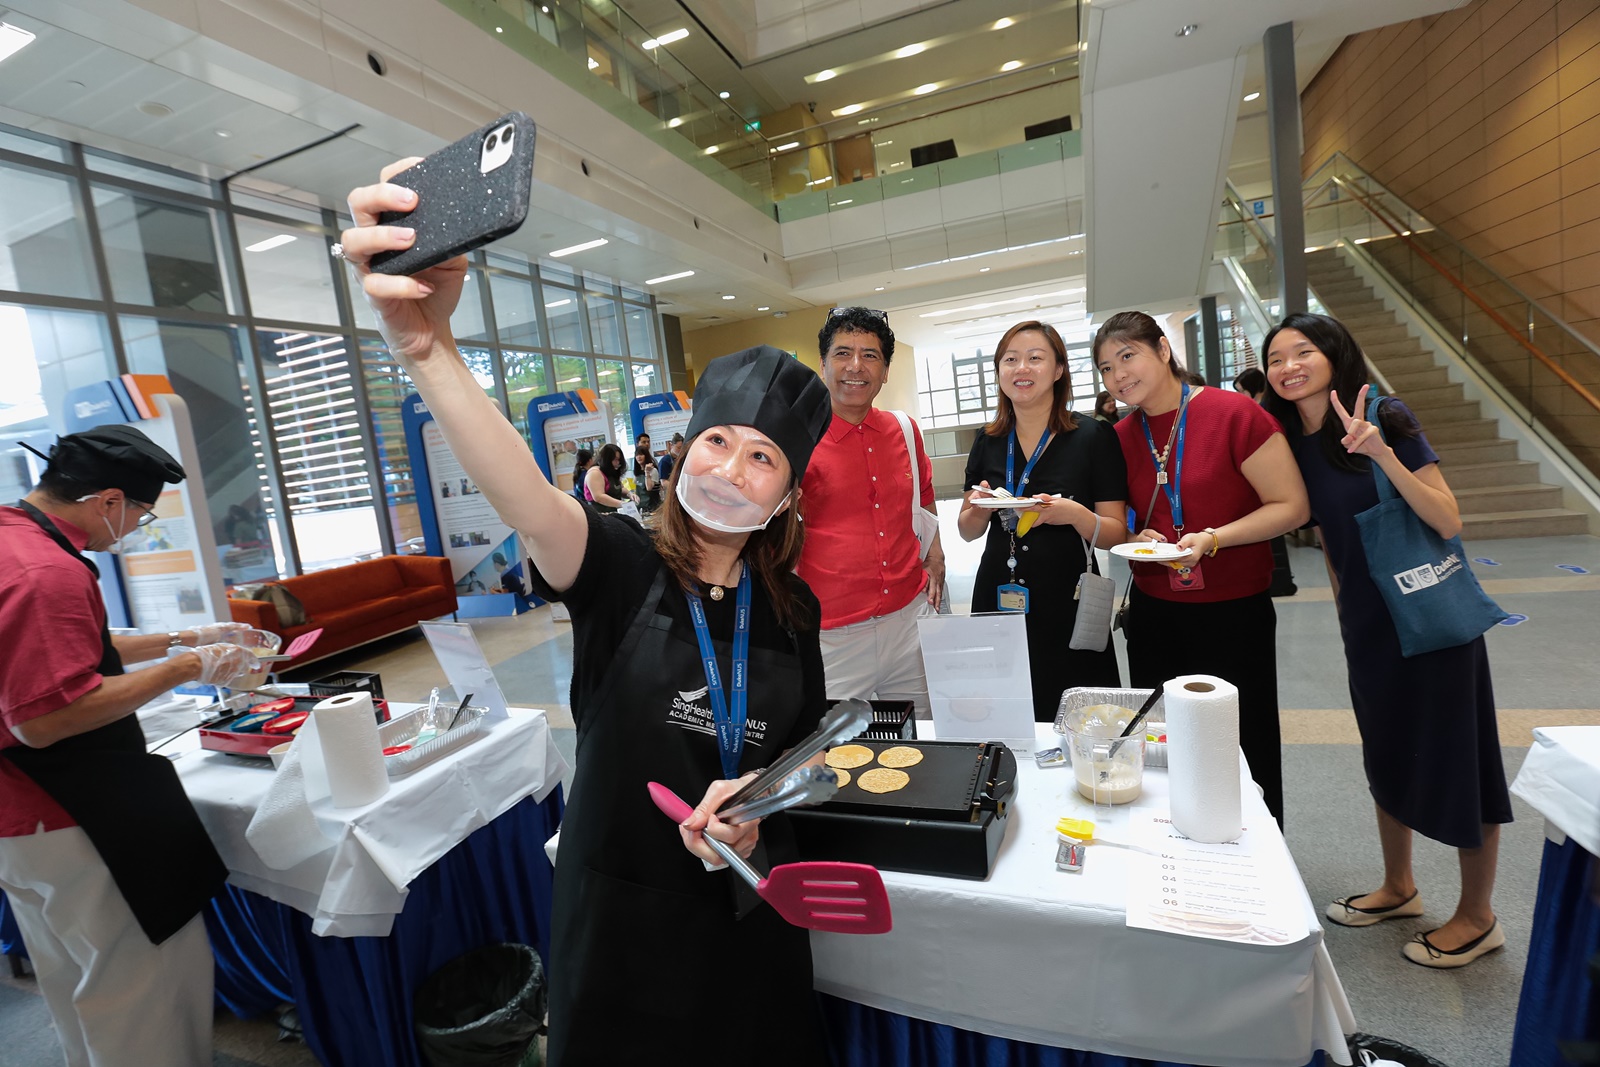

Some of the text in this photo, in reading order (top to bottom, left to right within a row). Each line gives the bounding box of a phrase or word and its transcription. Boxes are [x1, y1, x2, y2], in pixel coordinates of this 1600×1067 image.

[692, 601, 703, 624] DukeNUS
[708, 661, 718, 686] DukeNUS
[669, 710, 705, 726] ACADEMIC
[744, 730, 765, 740] ENTRE
[721, 725, 730, 751] DukeNUS
[733, 728, 741, 753] DukeNUS
